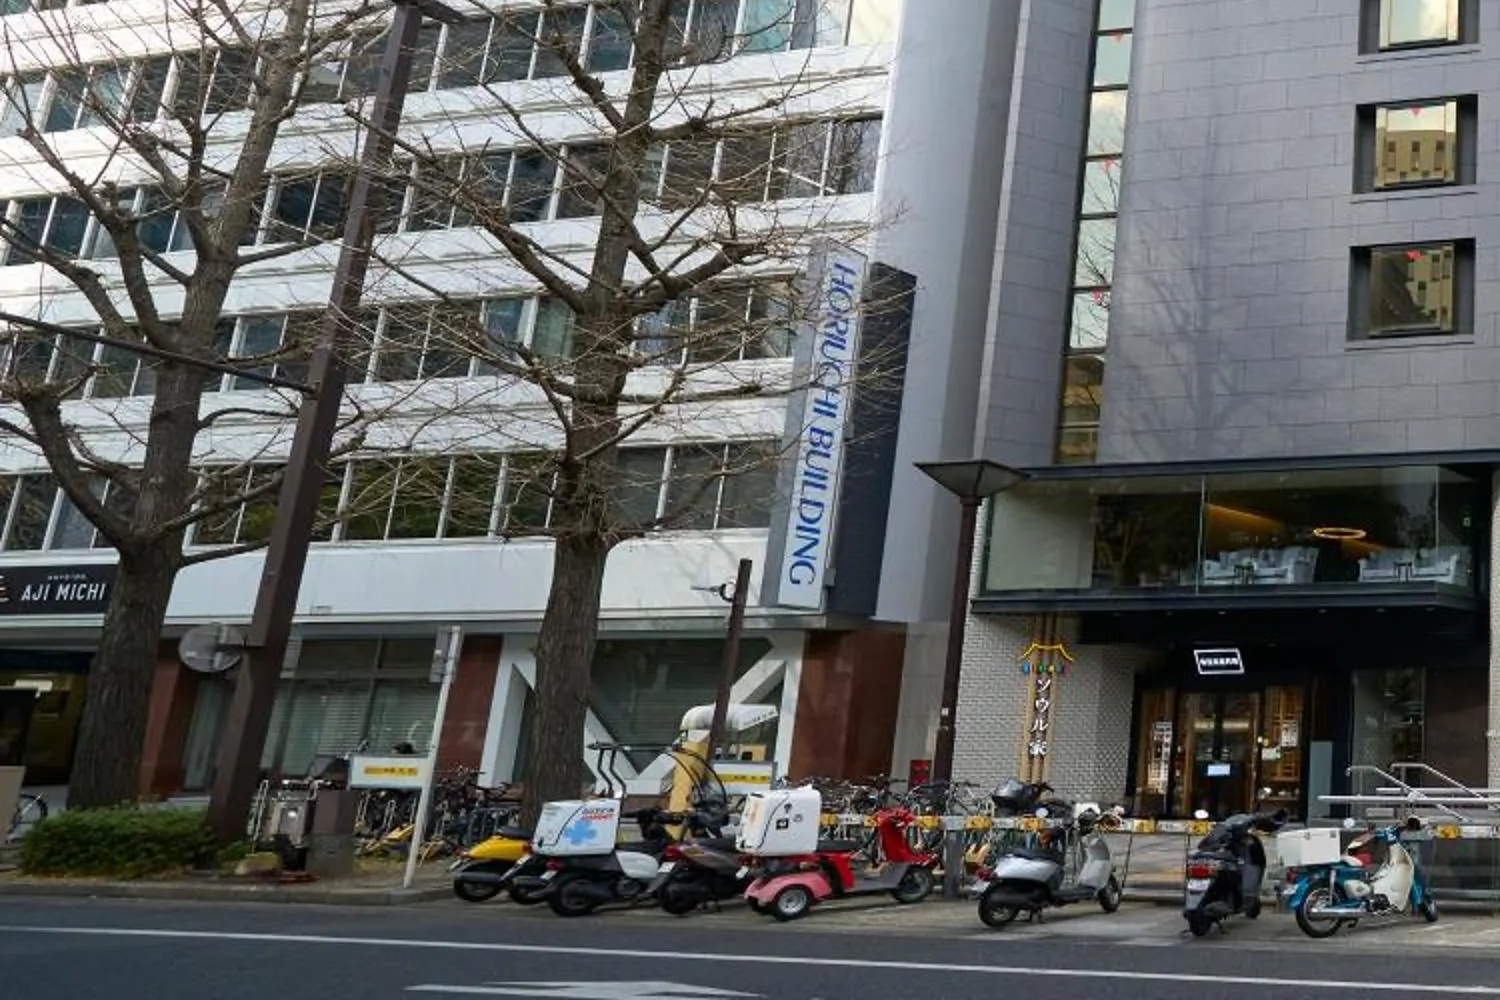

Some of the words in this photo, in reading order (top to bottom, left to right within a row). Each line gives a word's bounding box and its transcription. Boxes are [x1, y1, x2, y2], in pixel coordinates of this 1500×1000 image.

[811, 262, 857, 419] HORIUCHI
[788, 426, 835, 586] BUILDING
[21, 583, 51, 601] AJI
[55, 583, 107, 601] MICHI
